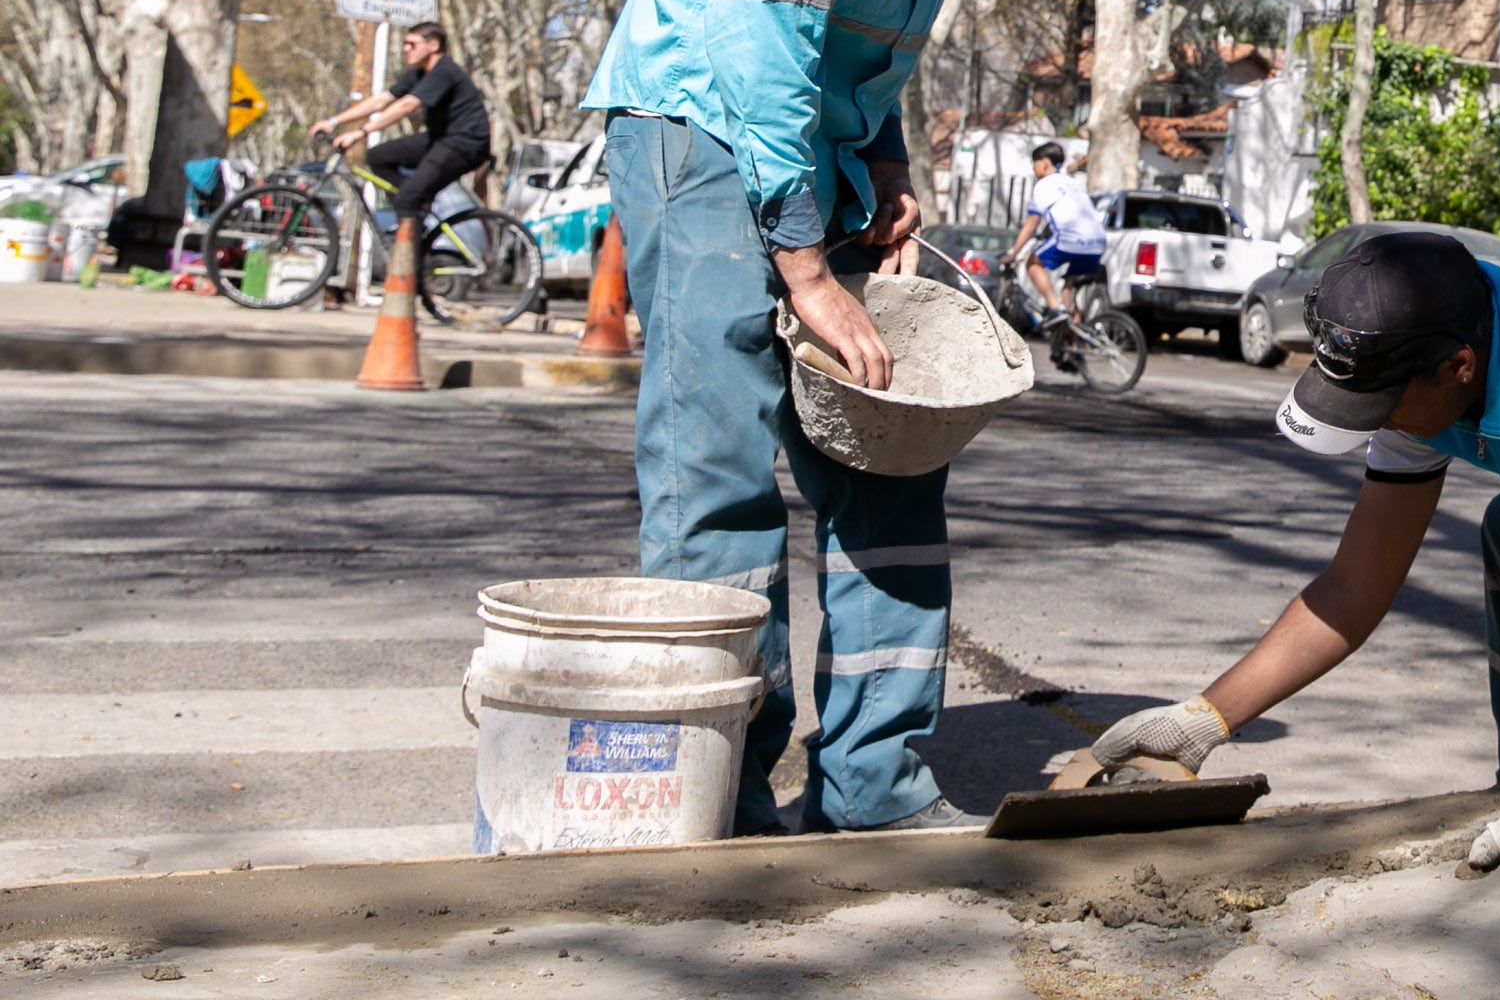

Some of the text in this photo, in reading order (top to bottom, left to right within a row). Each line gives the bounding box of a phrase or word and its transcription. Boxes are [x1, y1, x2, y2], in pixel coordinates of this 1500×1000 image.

[1279, 404, 1315, 436] Panama
[605, 746, 669, 760] WILLIAMS
[553, 776, 683, 810] LOXON
[553, 827, 618, 848] Exterior
